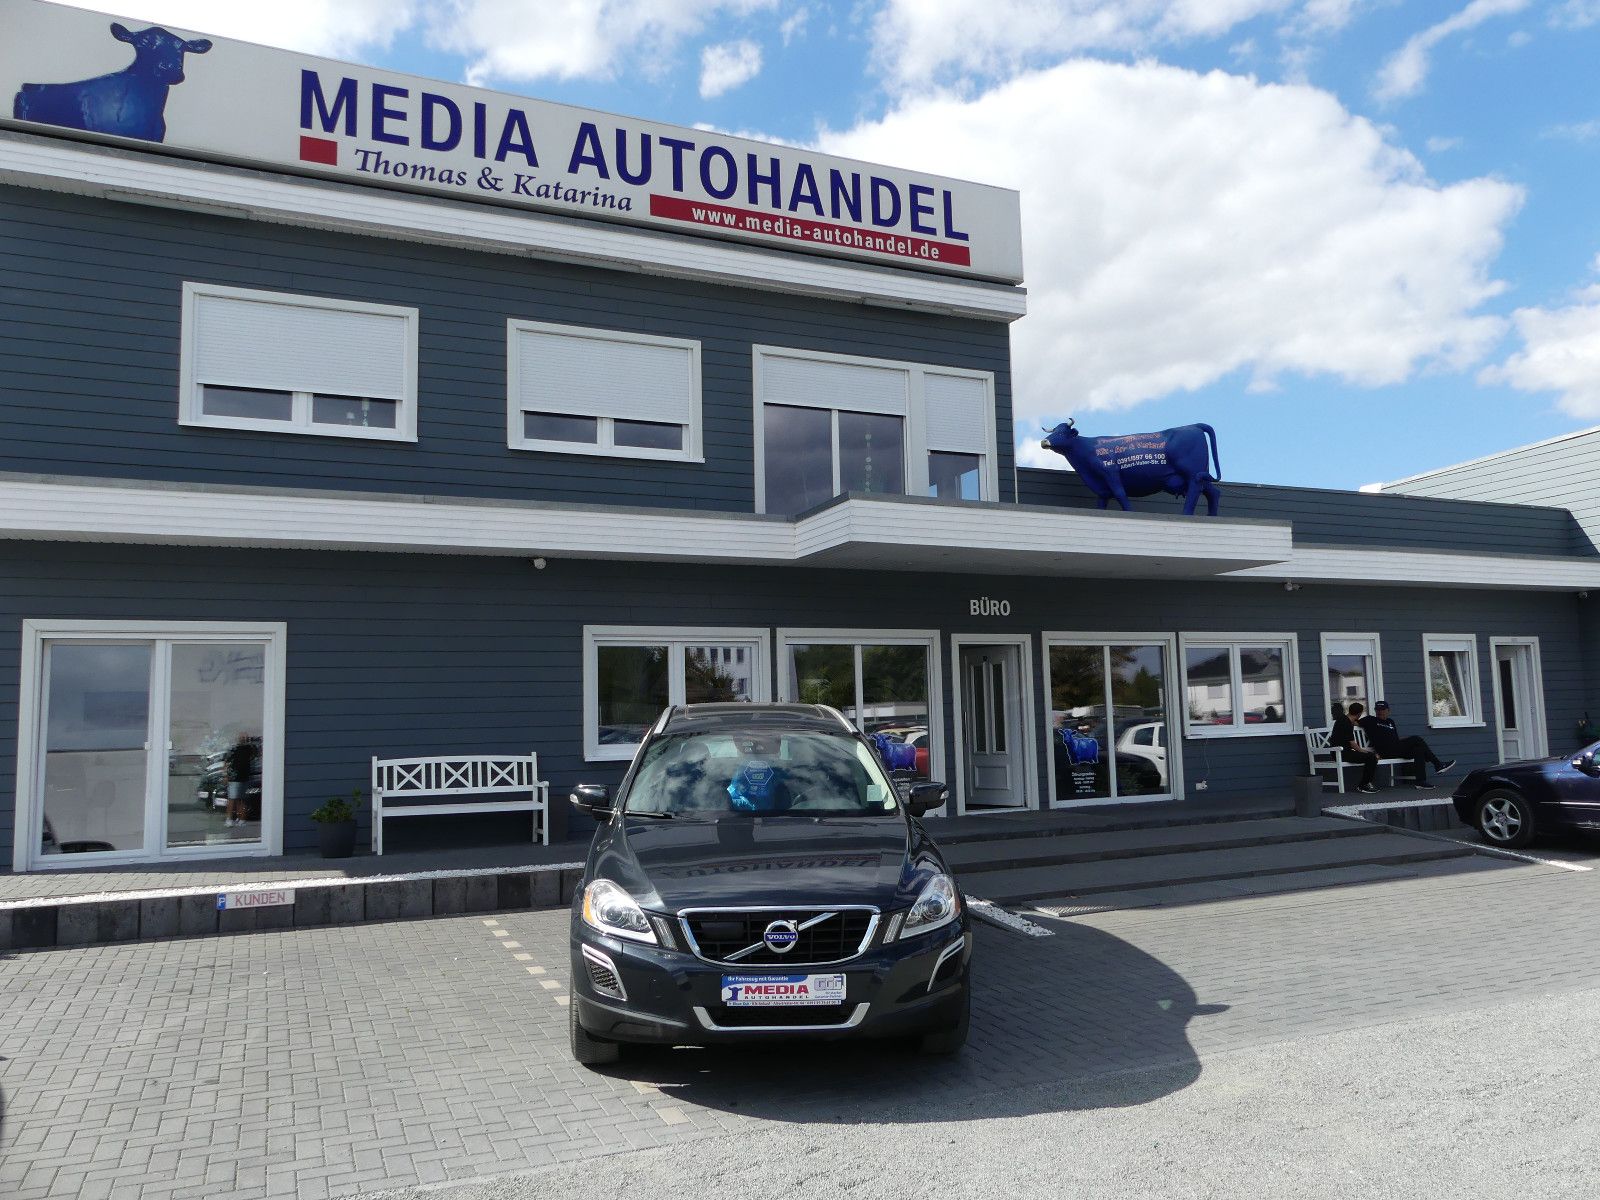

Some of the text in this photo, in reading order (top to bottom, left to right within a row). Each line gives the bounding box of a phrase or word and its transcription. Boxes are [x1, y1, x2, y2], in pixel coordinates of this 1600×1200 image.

[301, 69, 970, 241] MEDIA AUTOHANDEL
[354, 148, 633, 212] Thomas & Katarina
[692, 207, 940, 259] www.media-autohandel.de
[970, 596, 1011, 616] BÜRO
[234, 892, 286, 907] KUNDEN
[744, 984, 809, 995] MEDIA
